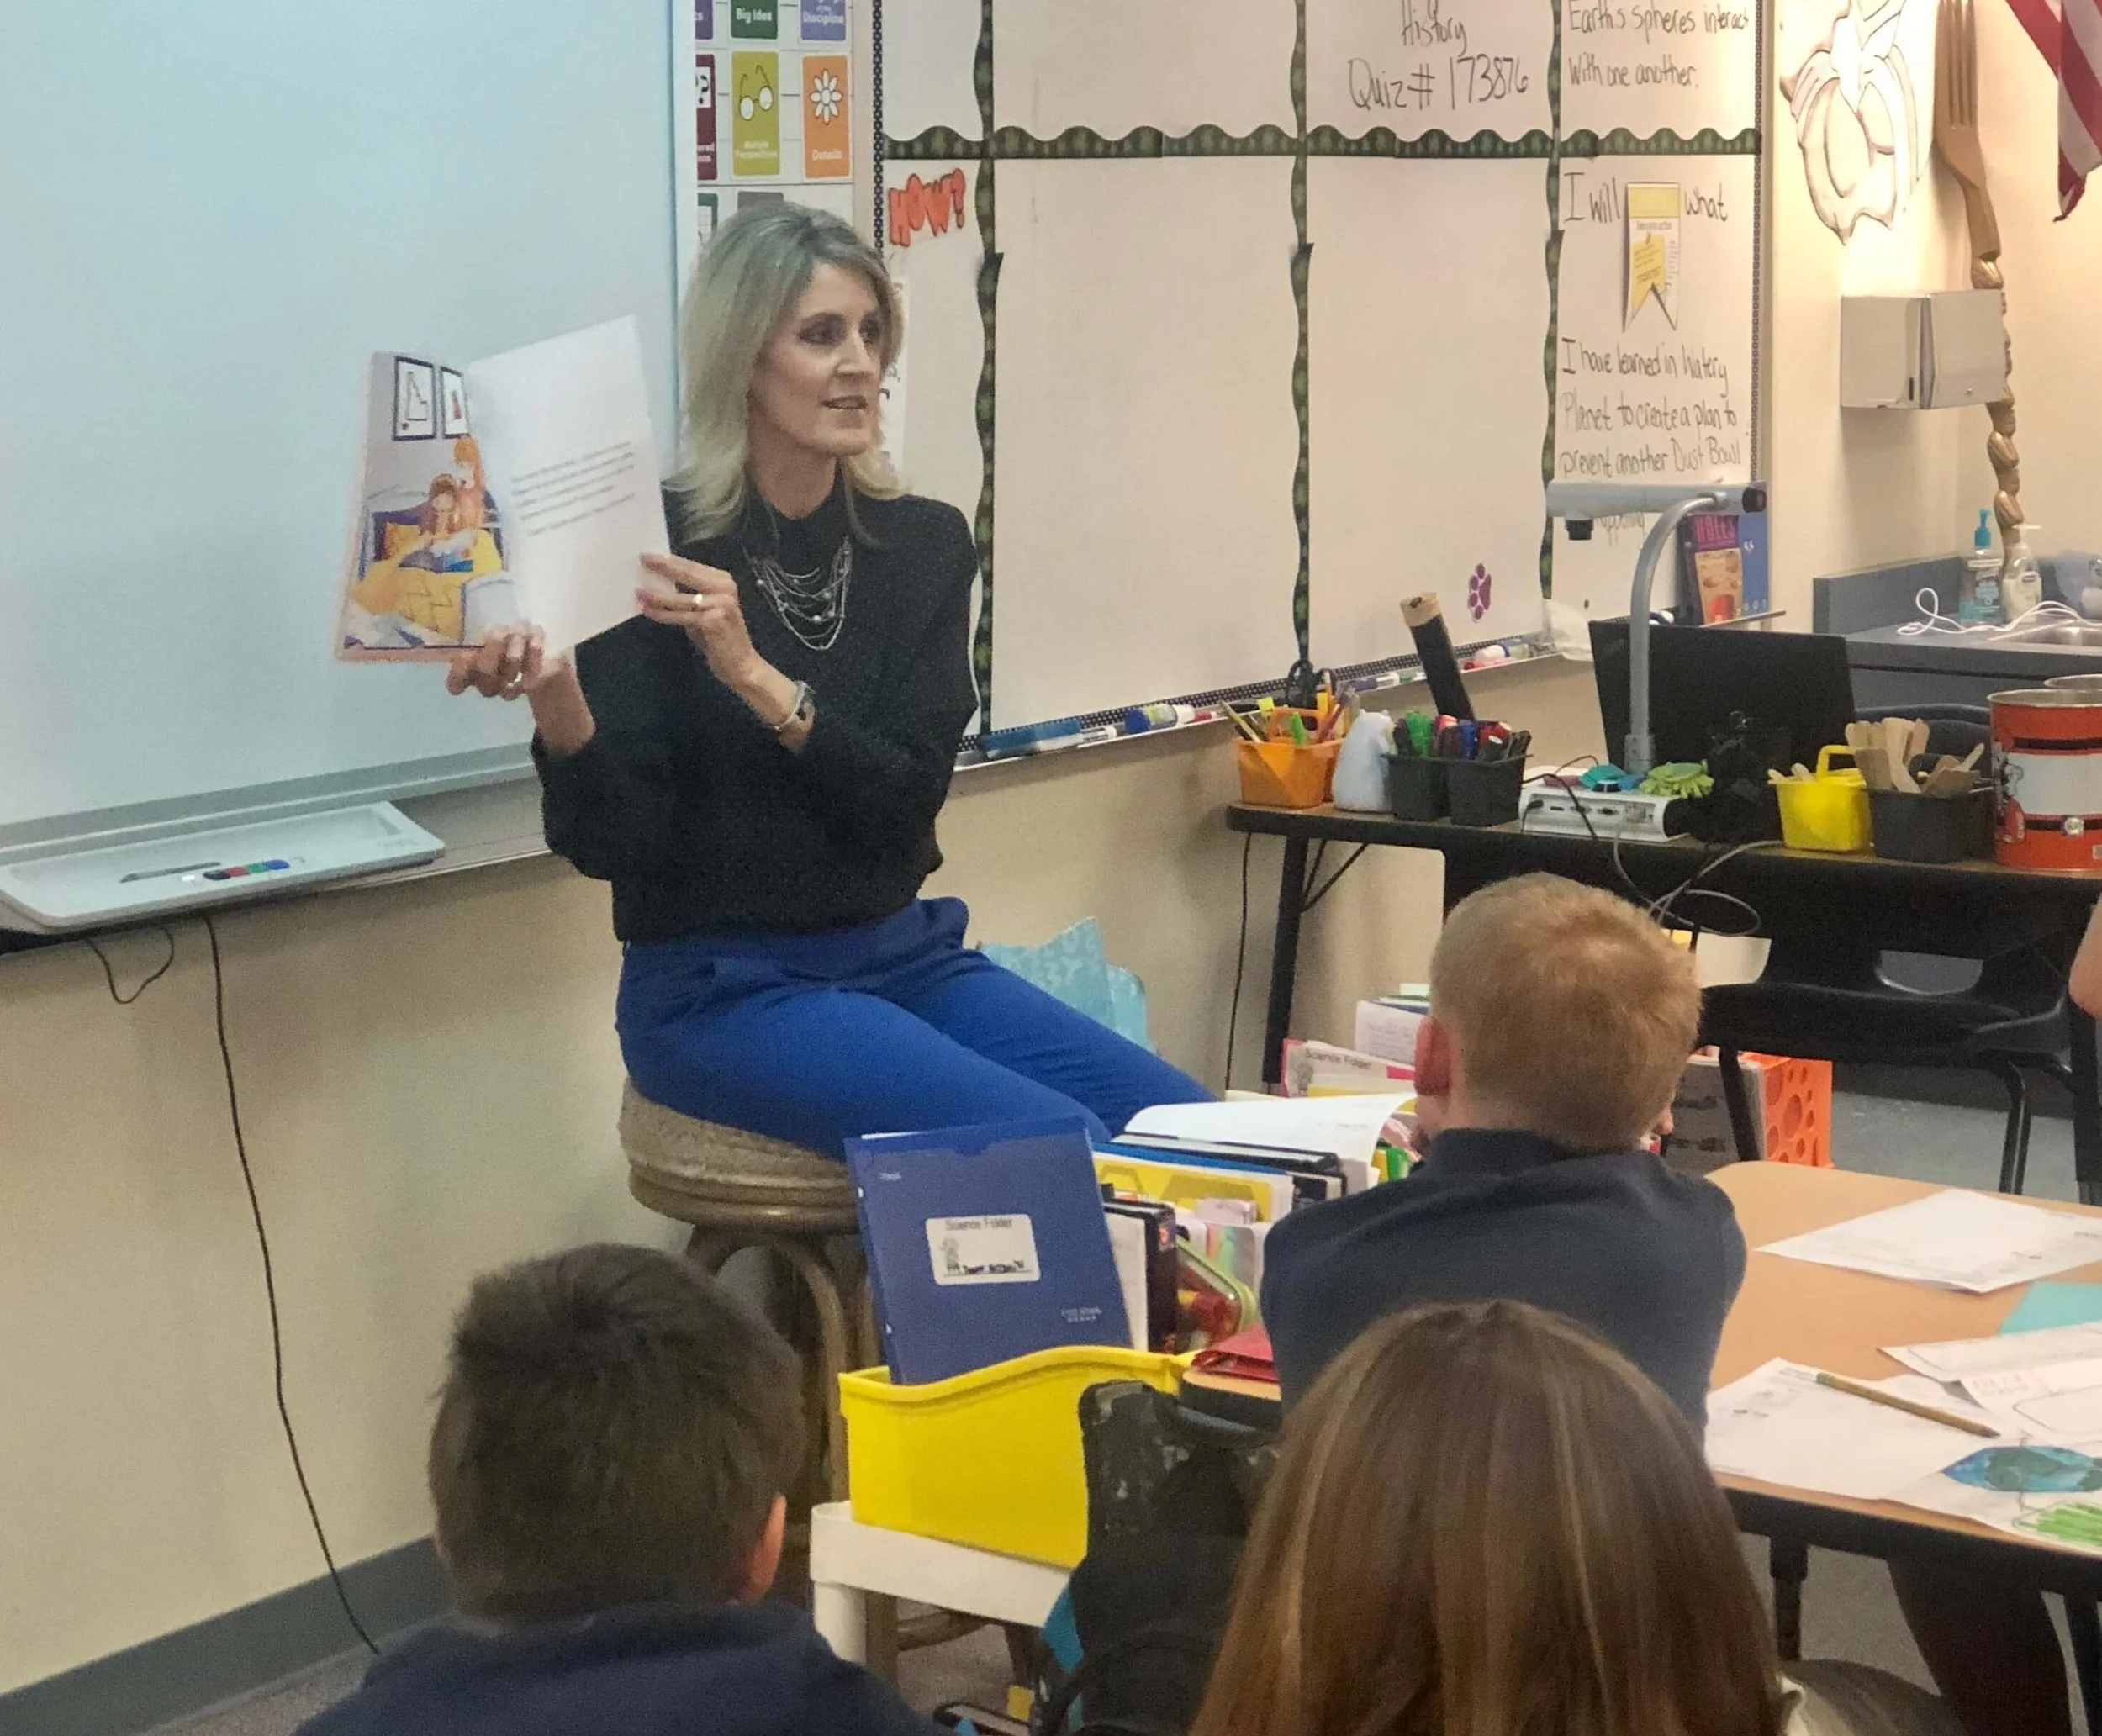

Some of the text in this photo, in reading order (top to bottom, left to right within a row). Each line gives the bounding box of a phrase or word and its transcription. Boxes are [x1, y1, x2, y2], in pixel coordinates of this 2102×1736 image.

[736, 8, 752, 24] Big
[1402, 0, 1467, 57] History
[1449, 53, 1529, 110] 173876
[1607, 65, 1630, 87] one
[1564, 171, 1585, 223] I
[1561, 337, 1576, 374] I
[1579, 341, 1613, 374] have
[1561, 386, 1613, 431] Planet
[1724, 399, 1737, 427] to
[1560, 446, 1613, 478] prevent
[1670, 436, 1704, 473] Dust
